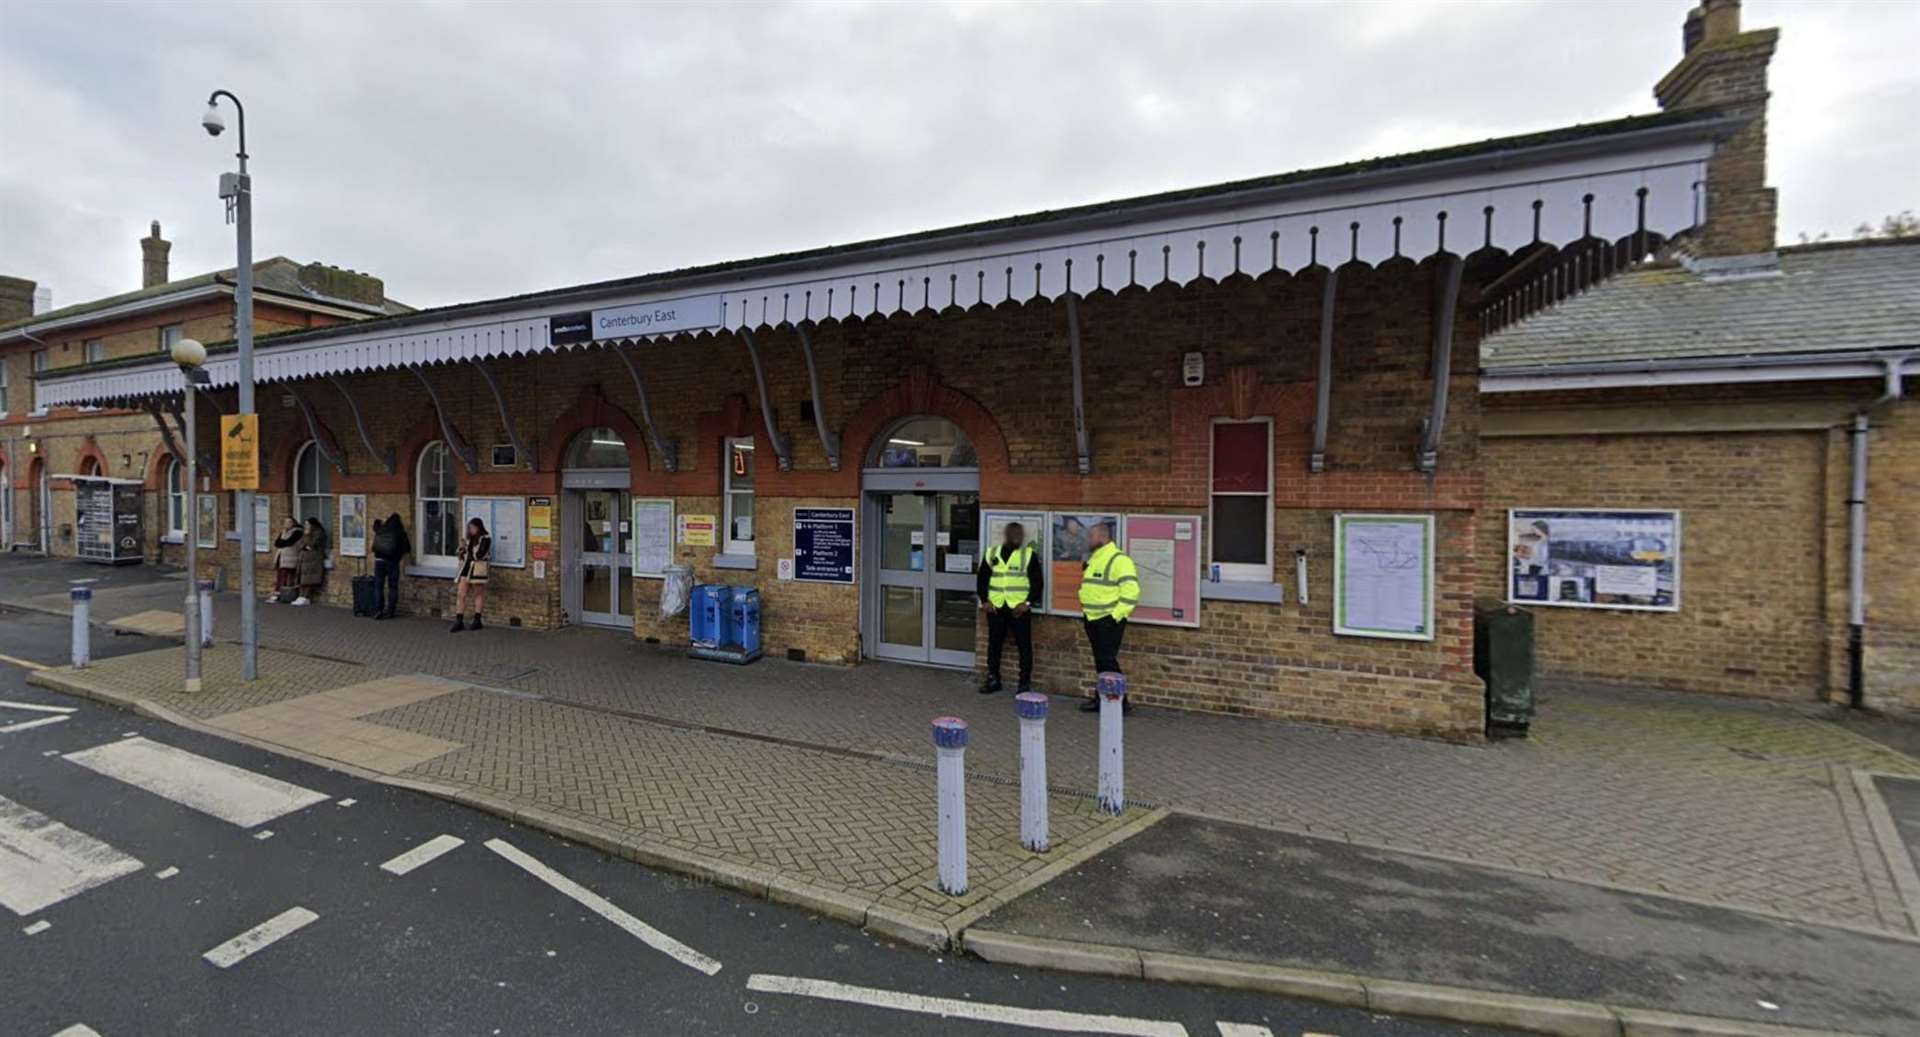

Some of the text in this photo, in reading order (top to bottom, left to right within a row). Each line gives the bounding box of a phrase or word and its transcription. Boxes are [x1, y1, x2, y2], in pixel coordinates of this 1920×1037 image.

[600, 312, 653, 330] Canterbury
[655, 309, 677, 323] East
[811, 511, 839, 519] Canterbury
[839, 511, 850, 519] East
